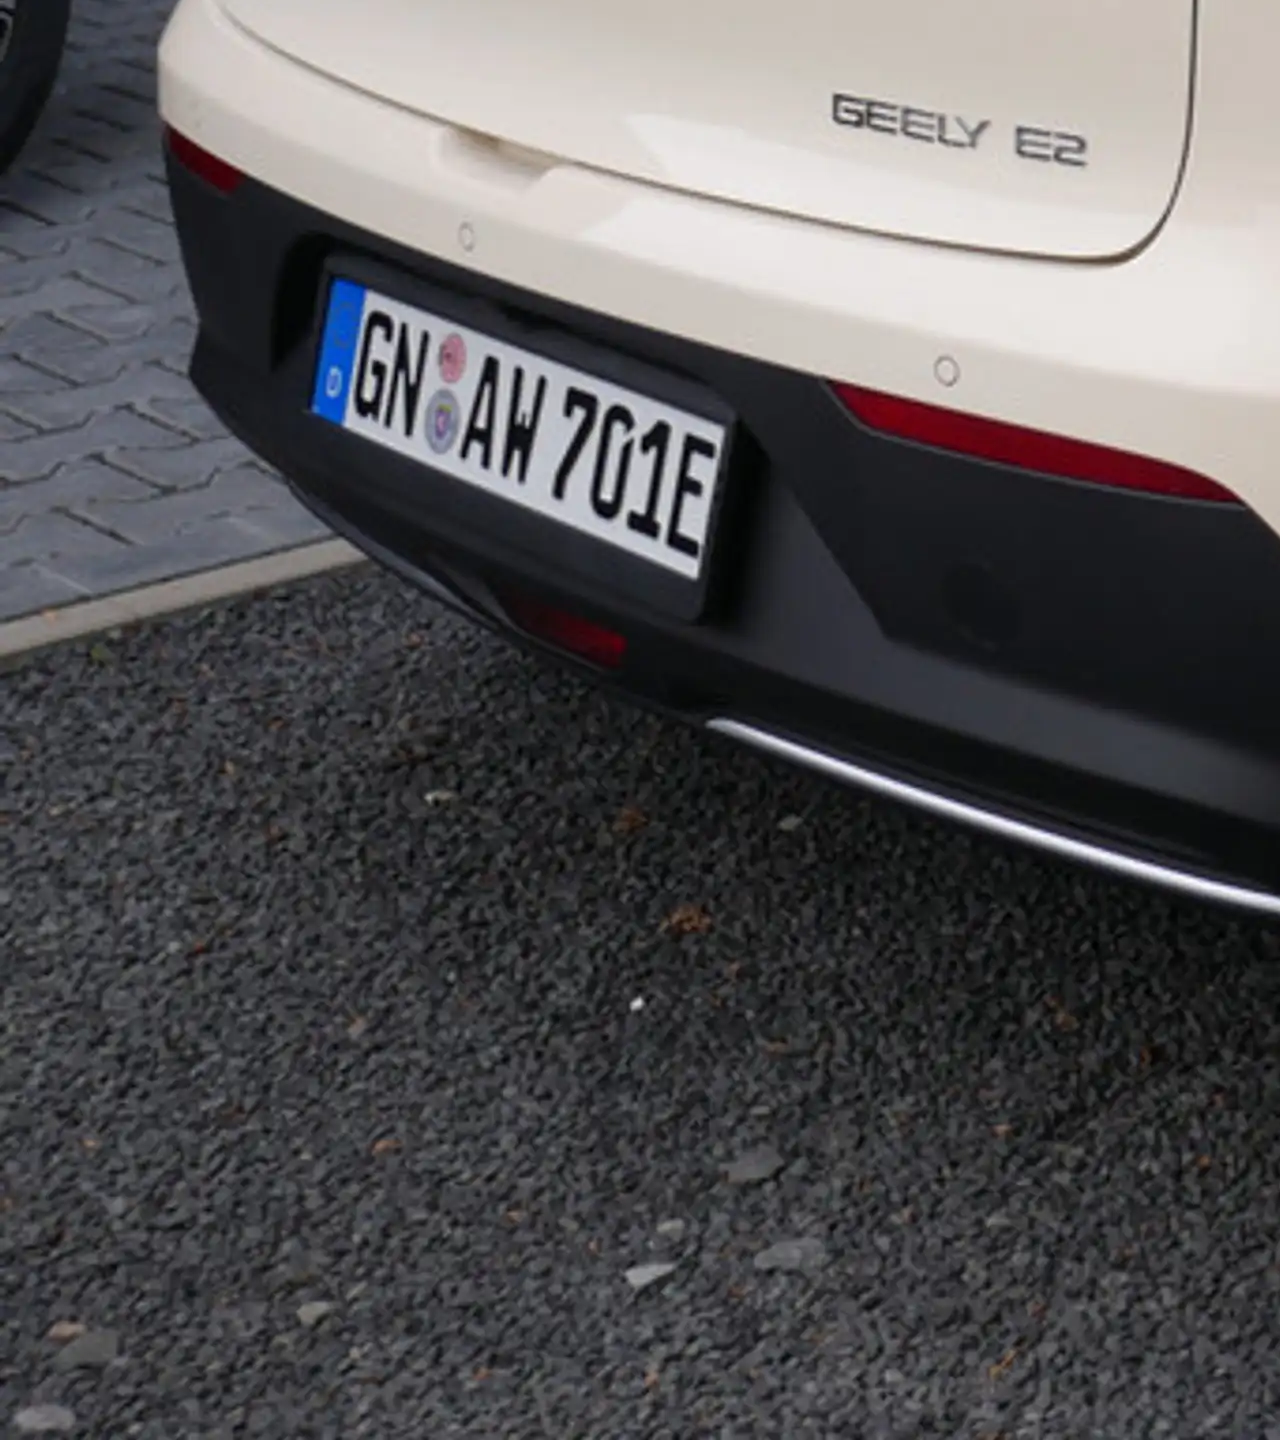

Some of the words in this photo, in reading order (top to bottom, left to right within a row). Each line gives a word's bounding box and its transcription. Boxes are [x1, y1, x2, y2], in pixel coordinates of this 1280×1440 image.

[832, 93, 992, 149] GEELY
[1015, 125, 1087, 167] E2
[353, 309, 431, 439] GN
[458, 354, 549, 485] AW
[550, 385, 718, 559] 701E
